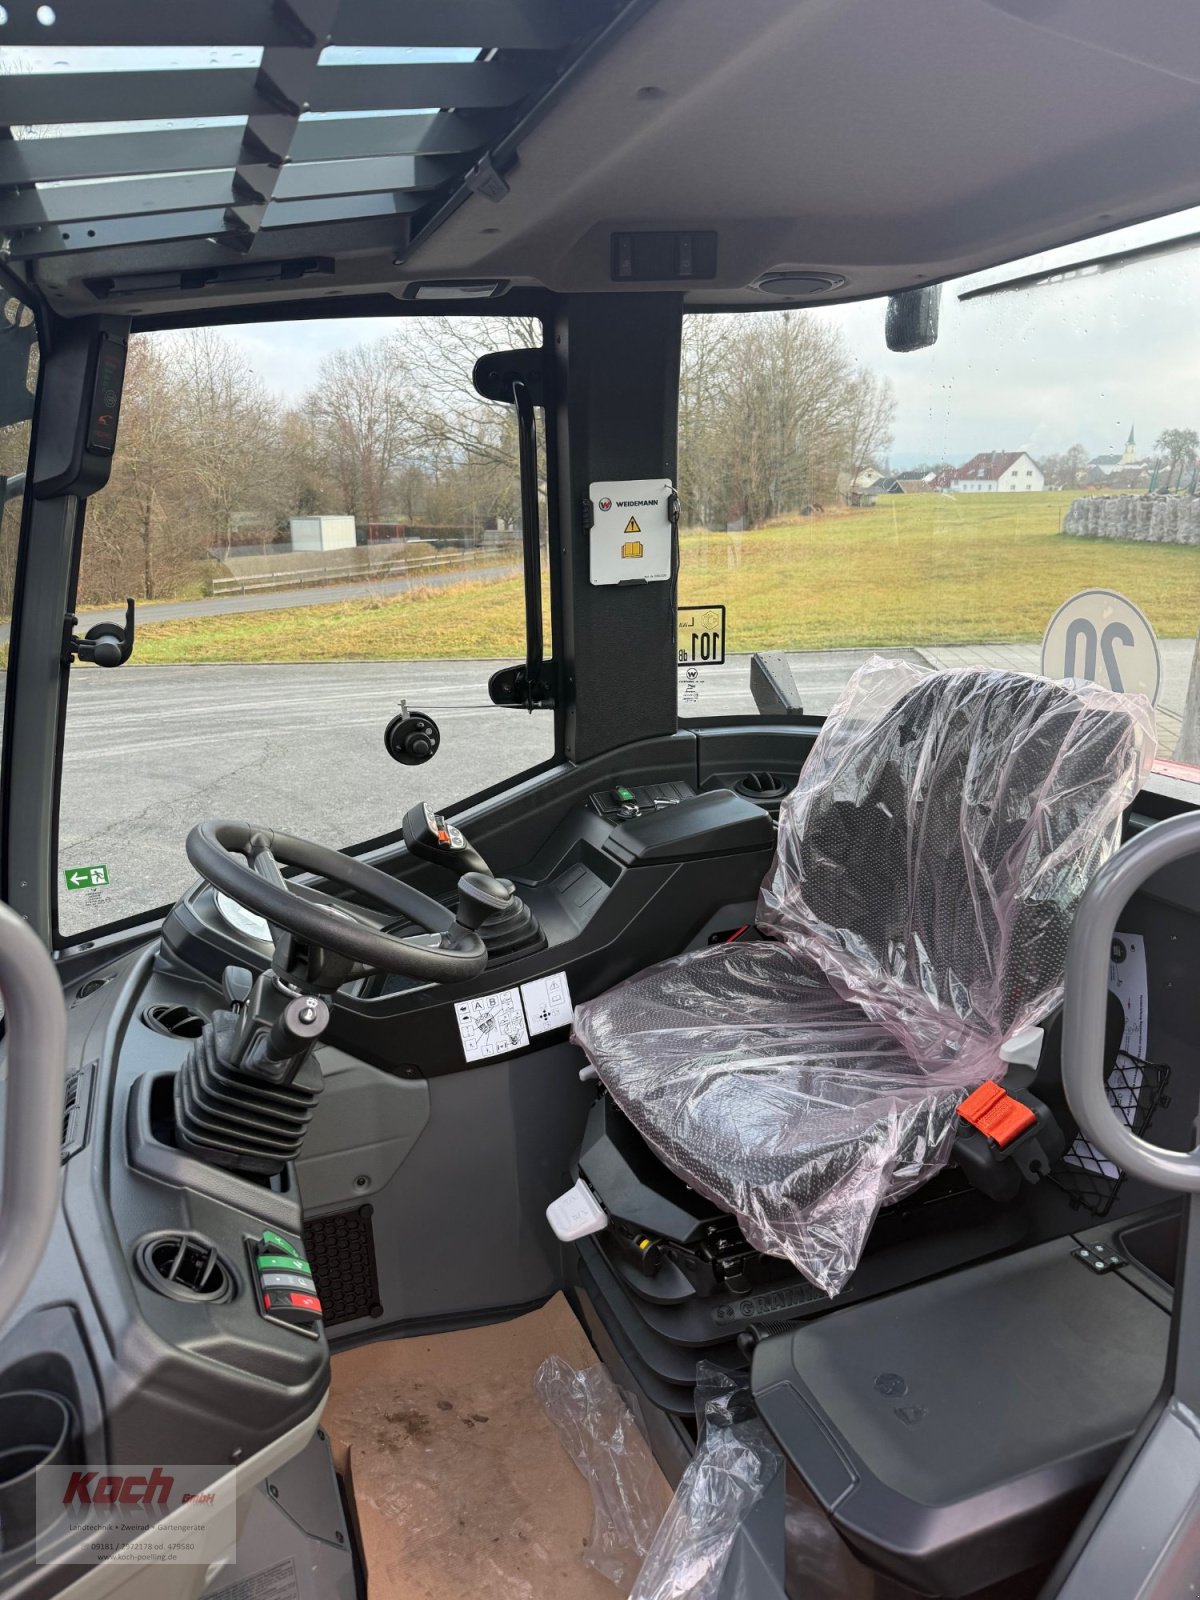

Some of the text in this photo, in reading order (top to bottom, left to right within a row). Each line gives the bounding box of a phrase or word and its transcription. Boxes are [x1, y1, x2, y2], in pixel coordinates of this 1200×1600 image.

[616, 500, 659, 508] WEIDEMANN
[475, 1001, 483, 1010] A
[489, 998, 497, 1006] B
